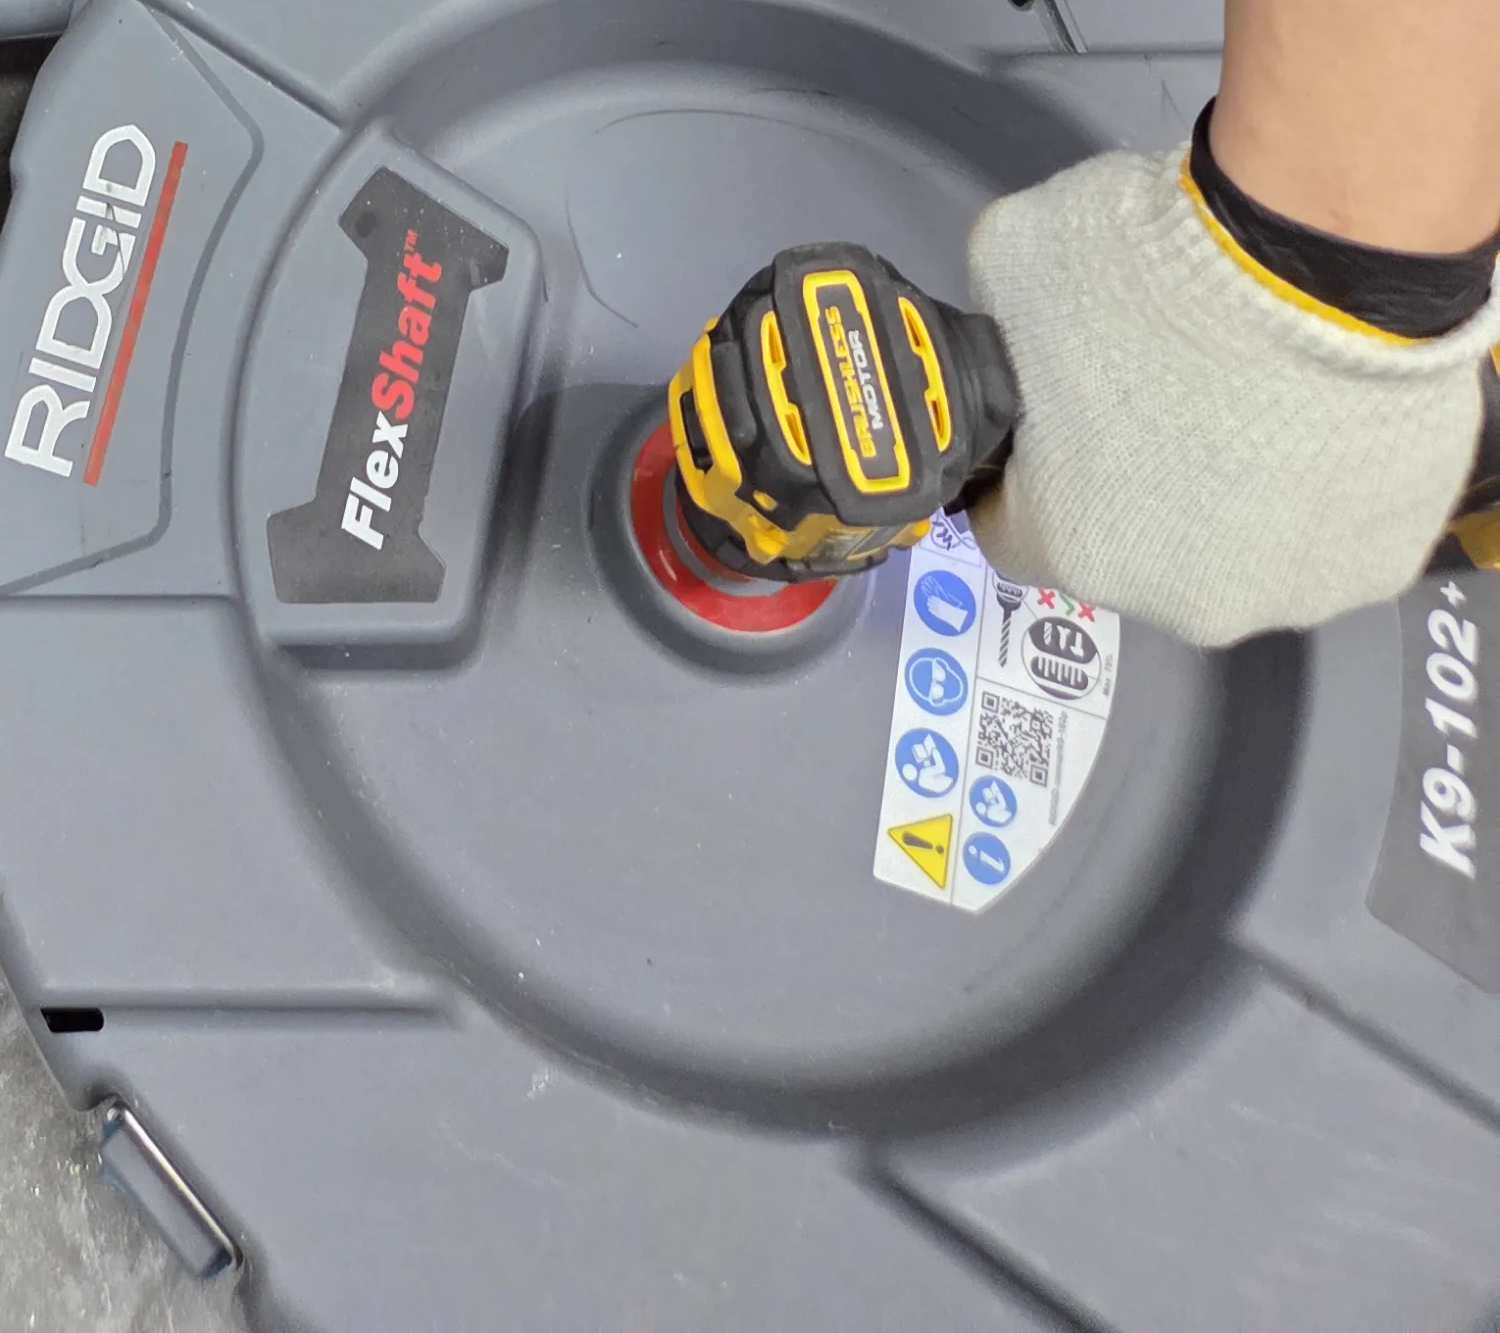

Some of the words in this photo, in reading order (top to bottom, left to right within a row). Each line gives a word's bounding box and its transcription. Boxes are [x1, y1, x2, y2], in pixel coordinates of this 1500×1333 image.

[4, 124, 156, 477] RIDGID
[825, 305, 876, 458] BRUSHLESS
[848, 329, 884, 430] MOTOR
[1419, 581, 1478, 880] K9-102+
